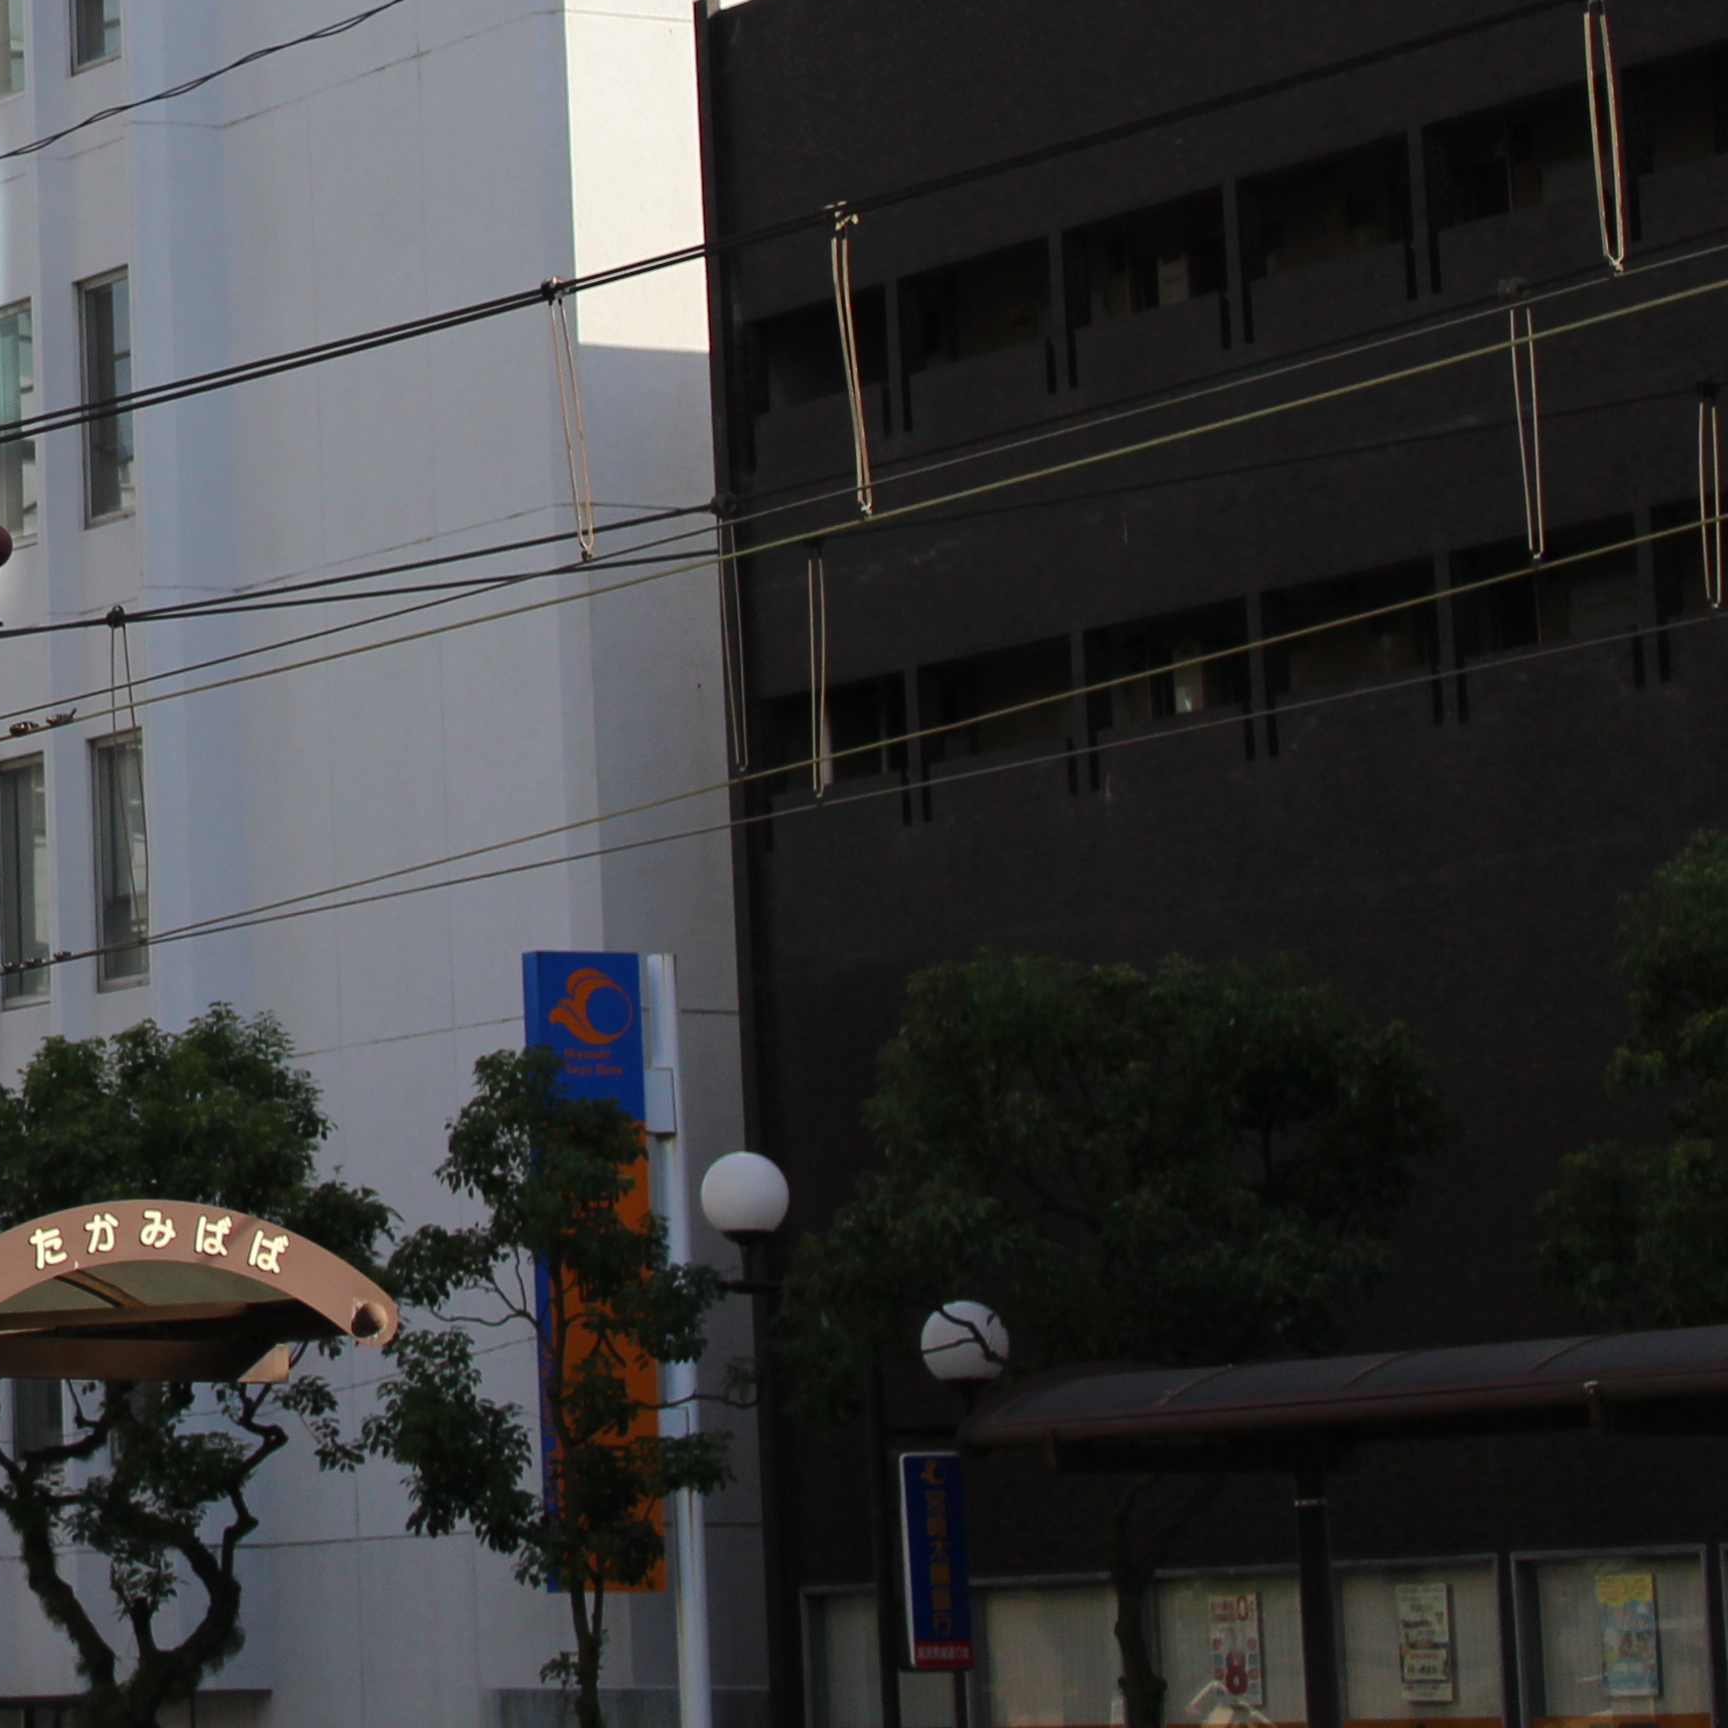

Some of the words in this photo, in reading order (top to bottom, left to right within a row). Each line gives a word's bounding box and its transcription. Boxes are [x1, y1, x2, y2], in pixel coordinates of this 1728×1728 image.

[28, 1208, 290, 1274] たかみばば
